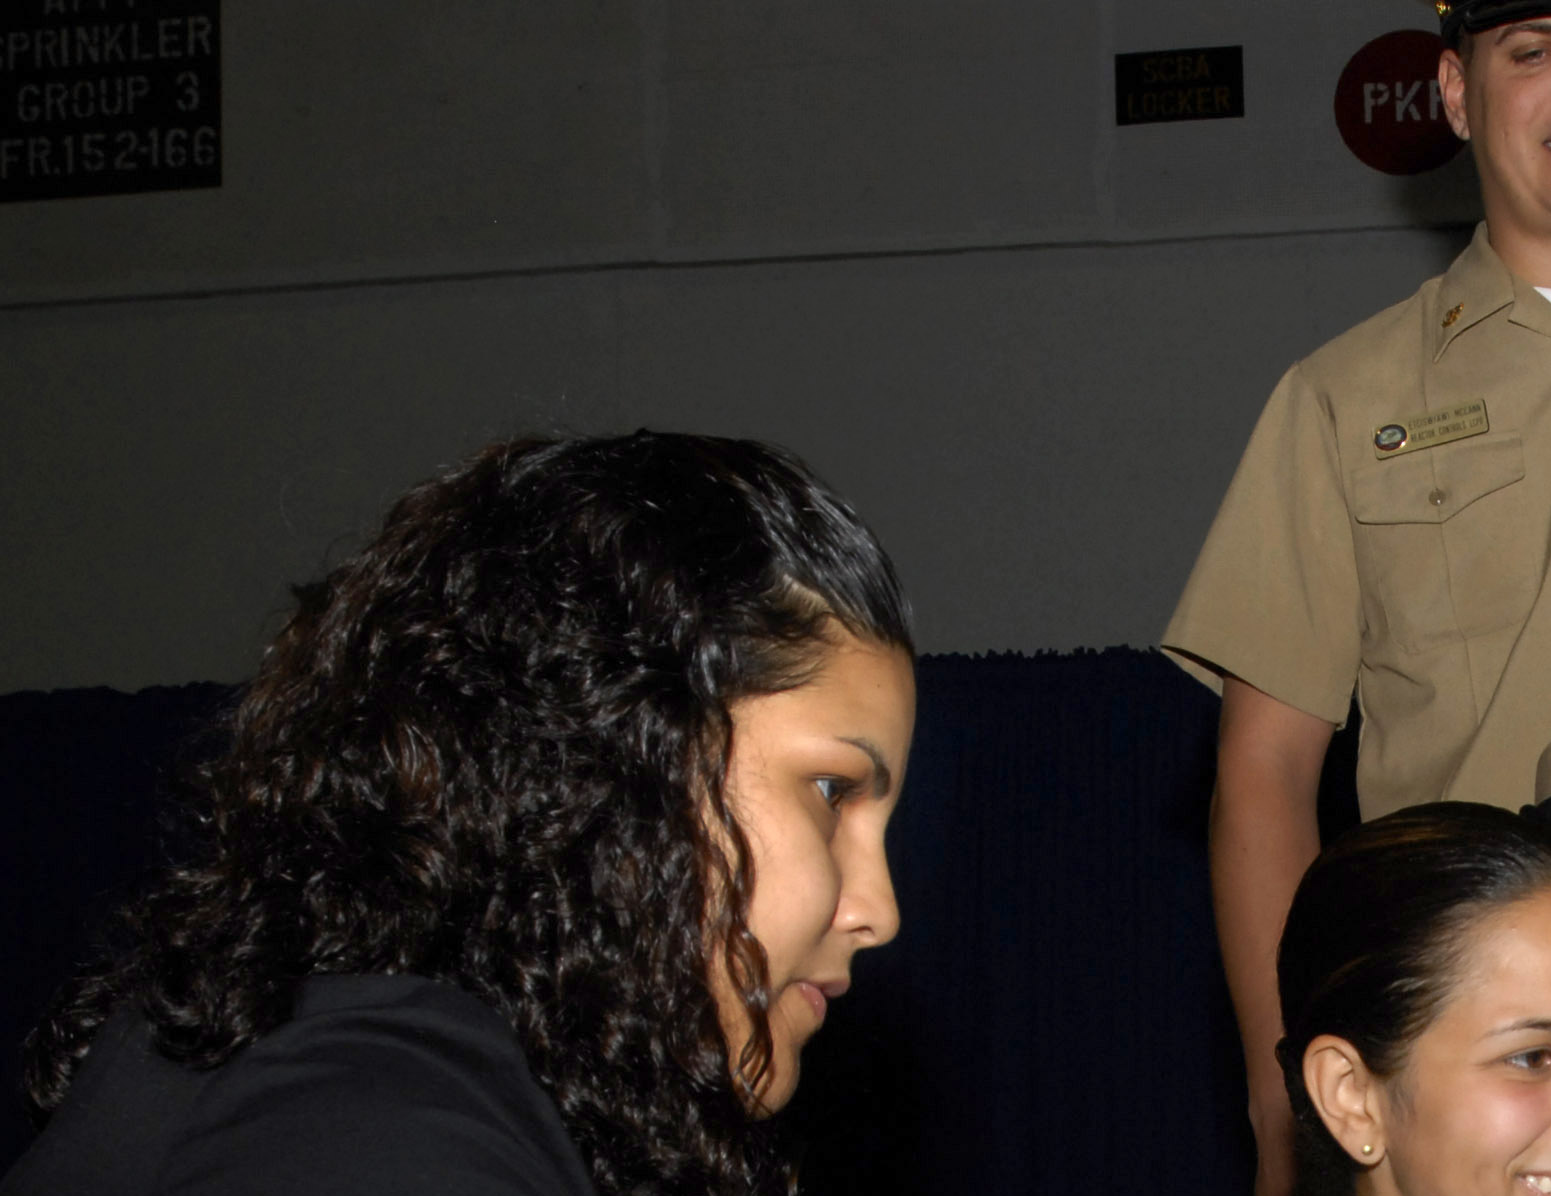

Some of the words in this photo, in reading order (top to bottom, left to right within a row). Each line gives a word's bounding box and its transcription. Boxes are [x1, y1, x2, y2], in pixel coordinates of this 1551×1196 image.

[0, 14, 212, 71] PRINKLER
[17, 75, 150, 122] GROUP
[175, 72, 200, 111] 3
[1127, 86, 1232, 120] LOCKER
[0, 126, 217, 179] FR.152-166
